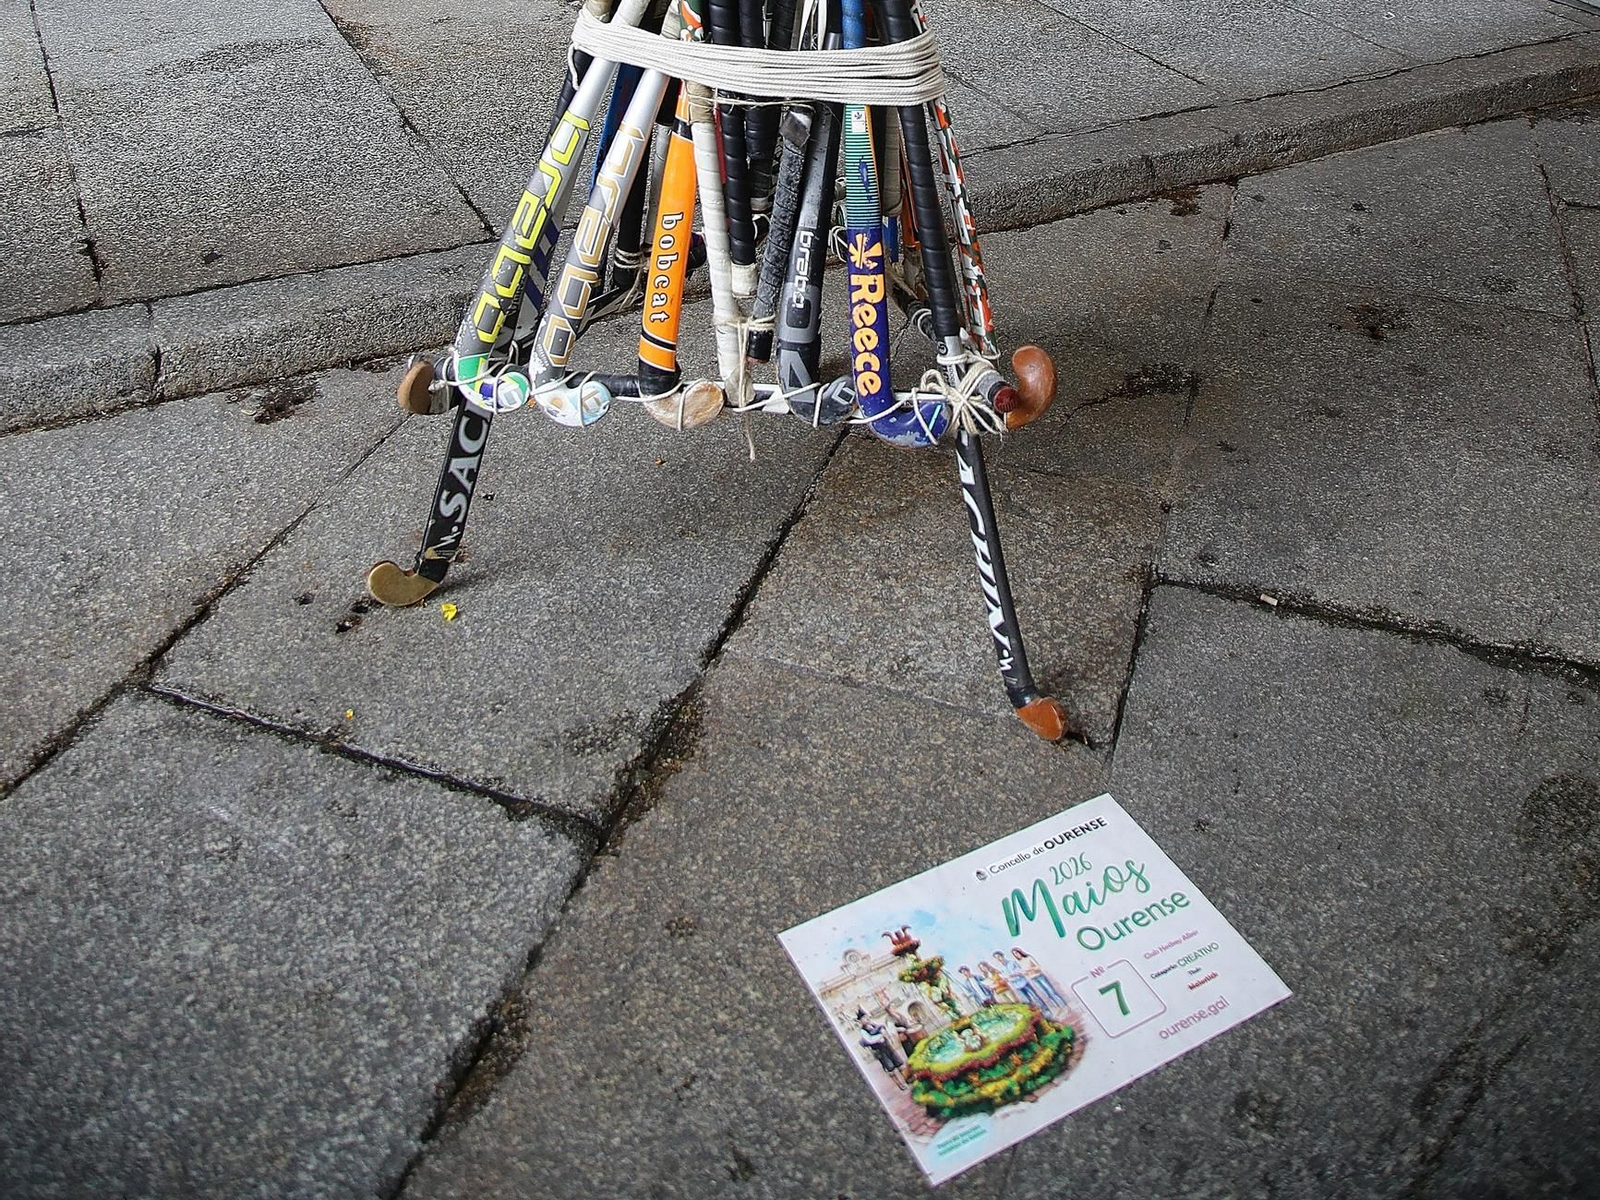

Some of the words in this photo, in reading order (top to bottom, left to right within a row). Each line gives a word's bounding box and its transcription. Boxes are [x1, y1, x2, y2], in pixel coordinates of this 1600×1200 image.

[650, 211, 684, 322] bobcat
[790, 230, 816, 309] brabo
[849, 274, 888, 396] Reece
[989, 851, 1031, 876] Concello
[1032, 845, 1044, 859] de
[1044, 816, 1107, 851] OURENSE
[1050, 853, 1093, 887] 2026
[1002, 857, 1150, 938] Maios
[1076, 888, 1191, 952] Ourense
[1178, 942, 1219, 967] CREATIVO
[1098, 980, 1131, 1017] 7
[1158, 996, 1230, 1041] ourense.gal
